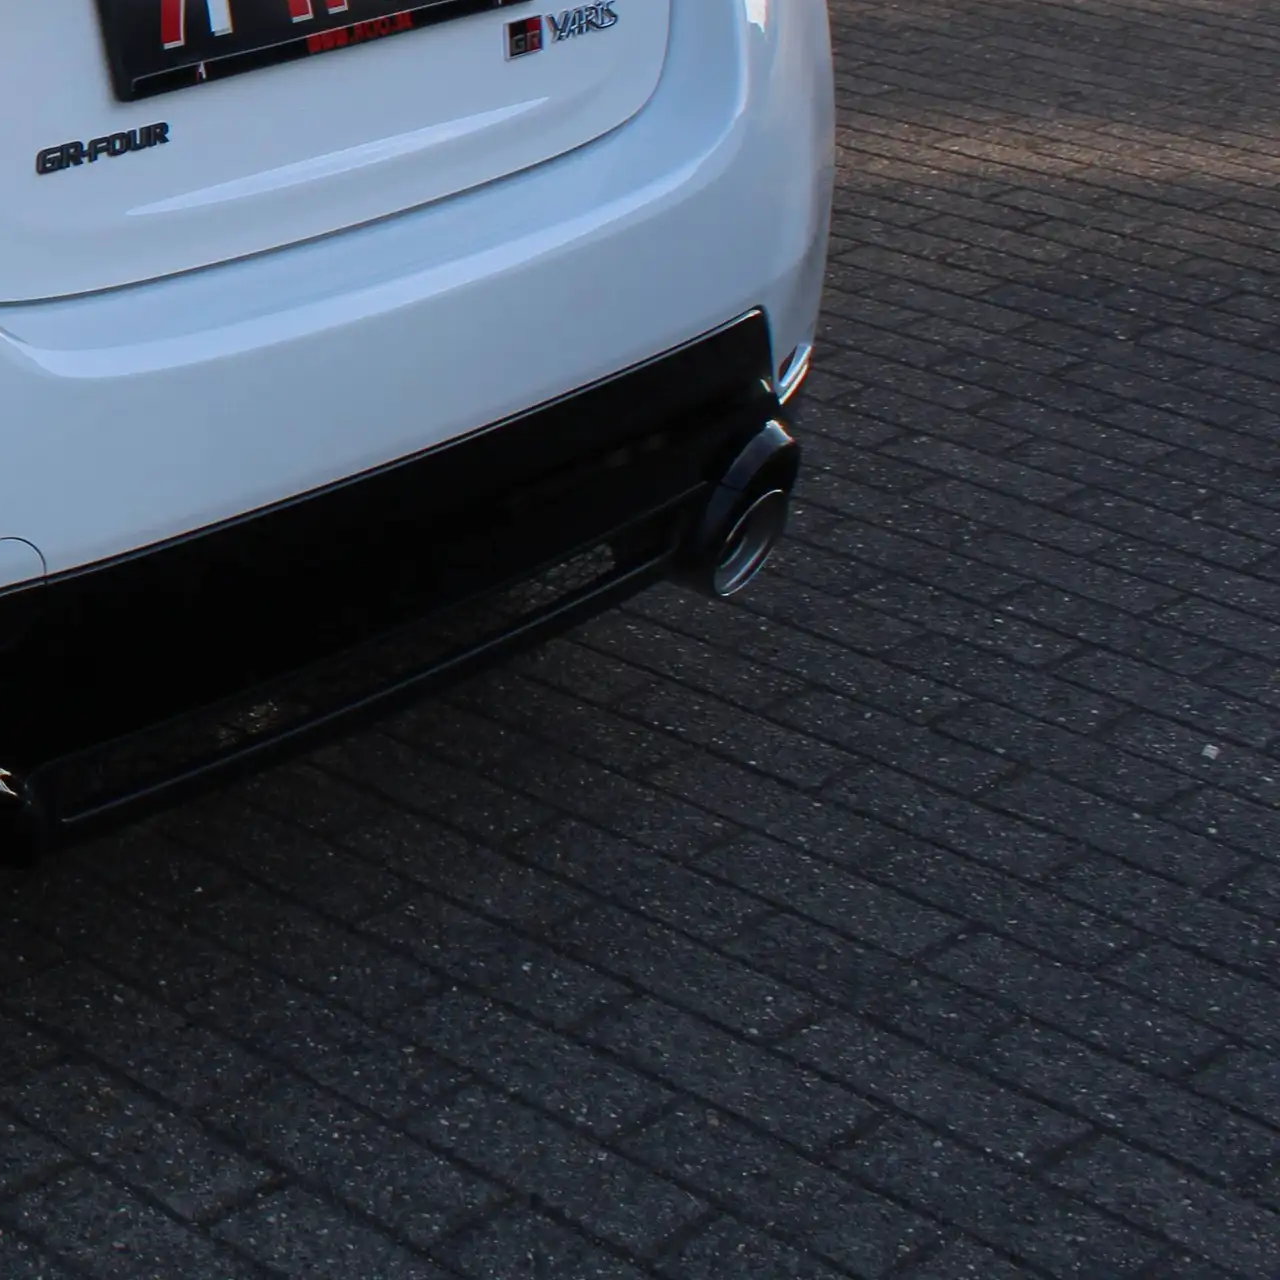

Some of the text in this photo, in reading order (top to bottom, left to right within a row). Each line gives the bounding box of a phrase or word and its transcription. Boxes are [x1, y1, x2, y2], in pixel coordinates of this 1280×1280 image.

[509, 0, 618, 56] GR YARIS
[36, 121, 170, 175] GR-FOUR
